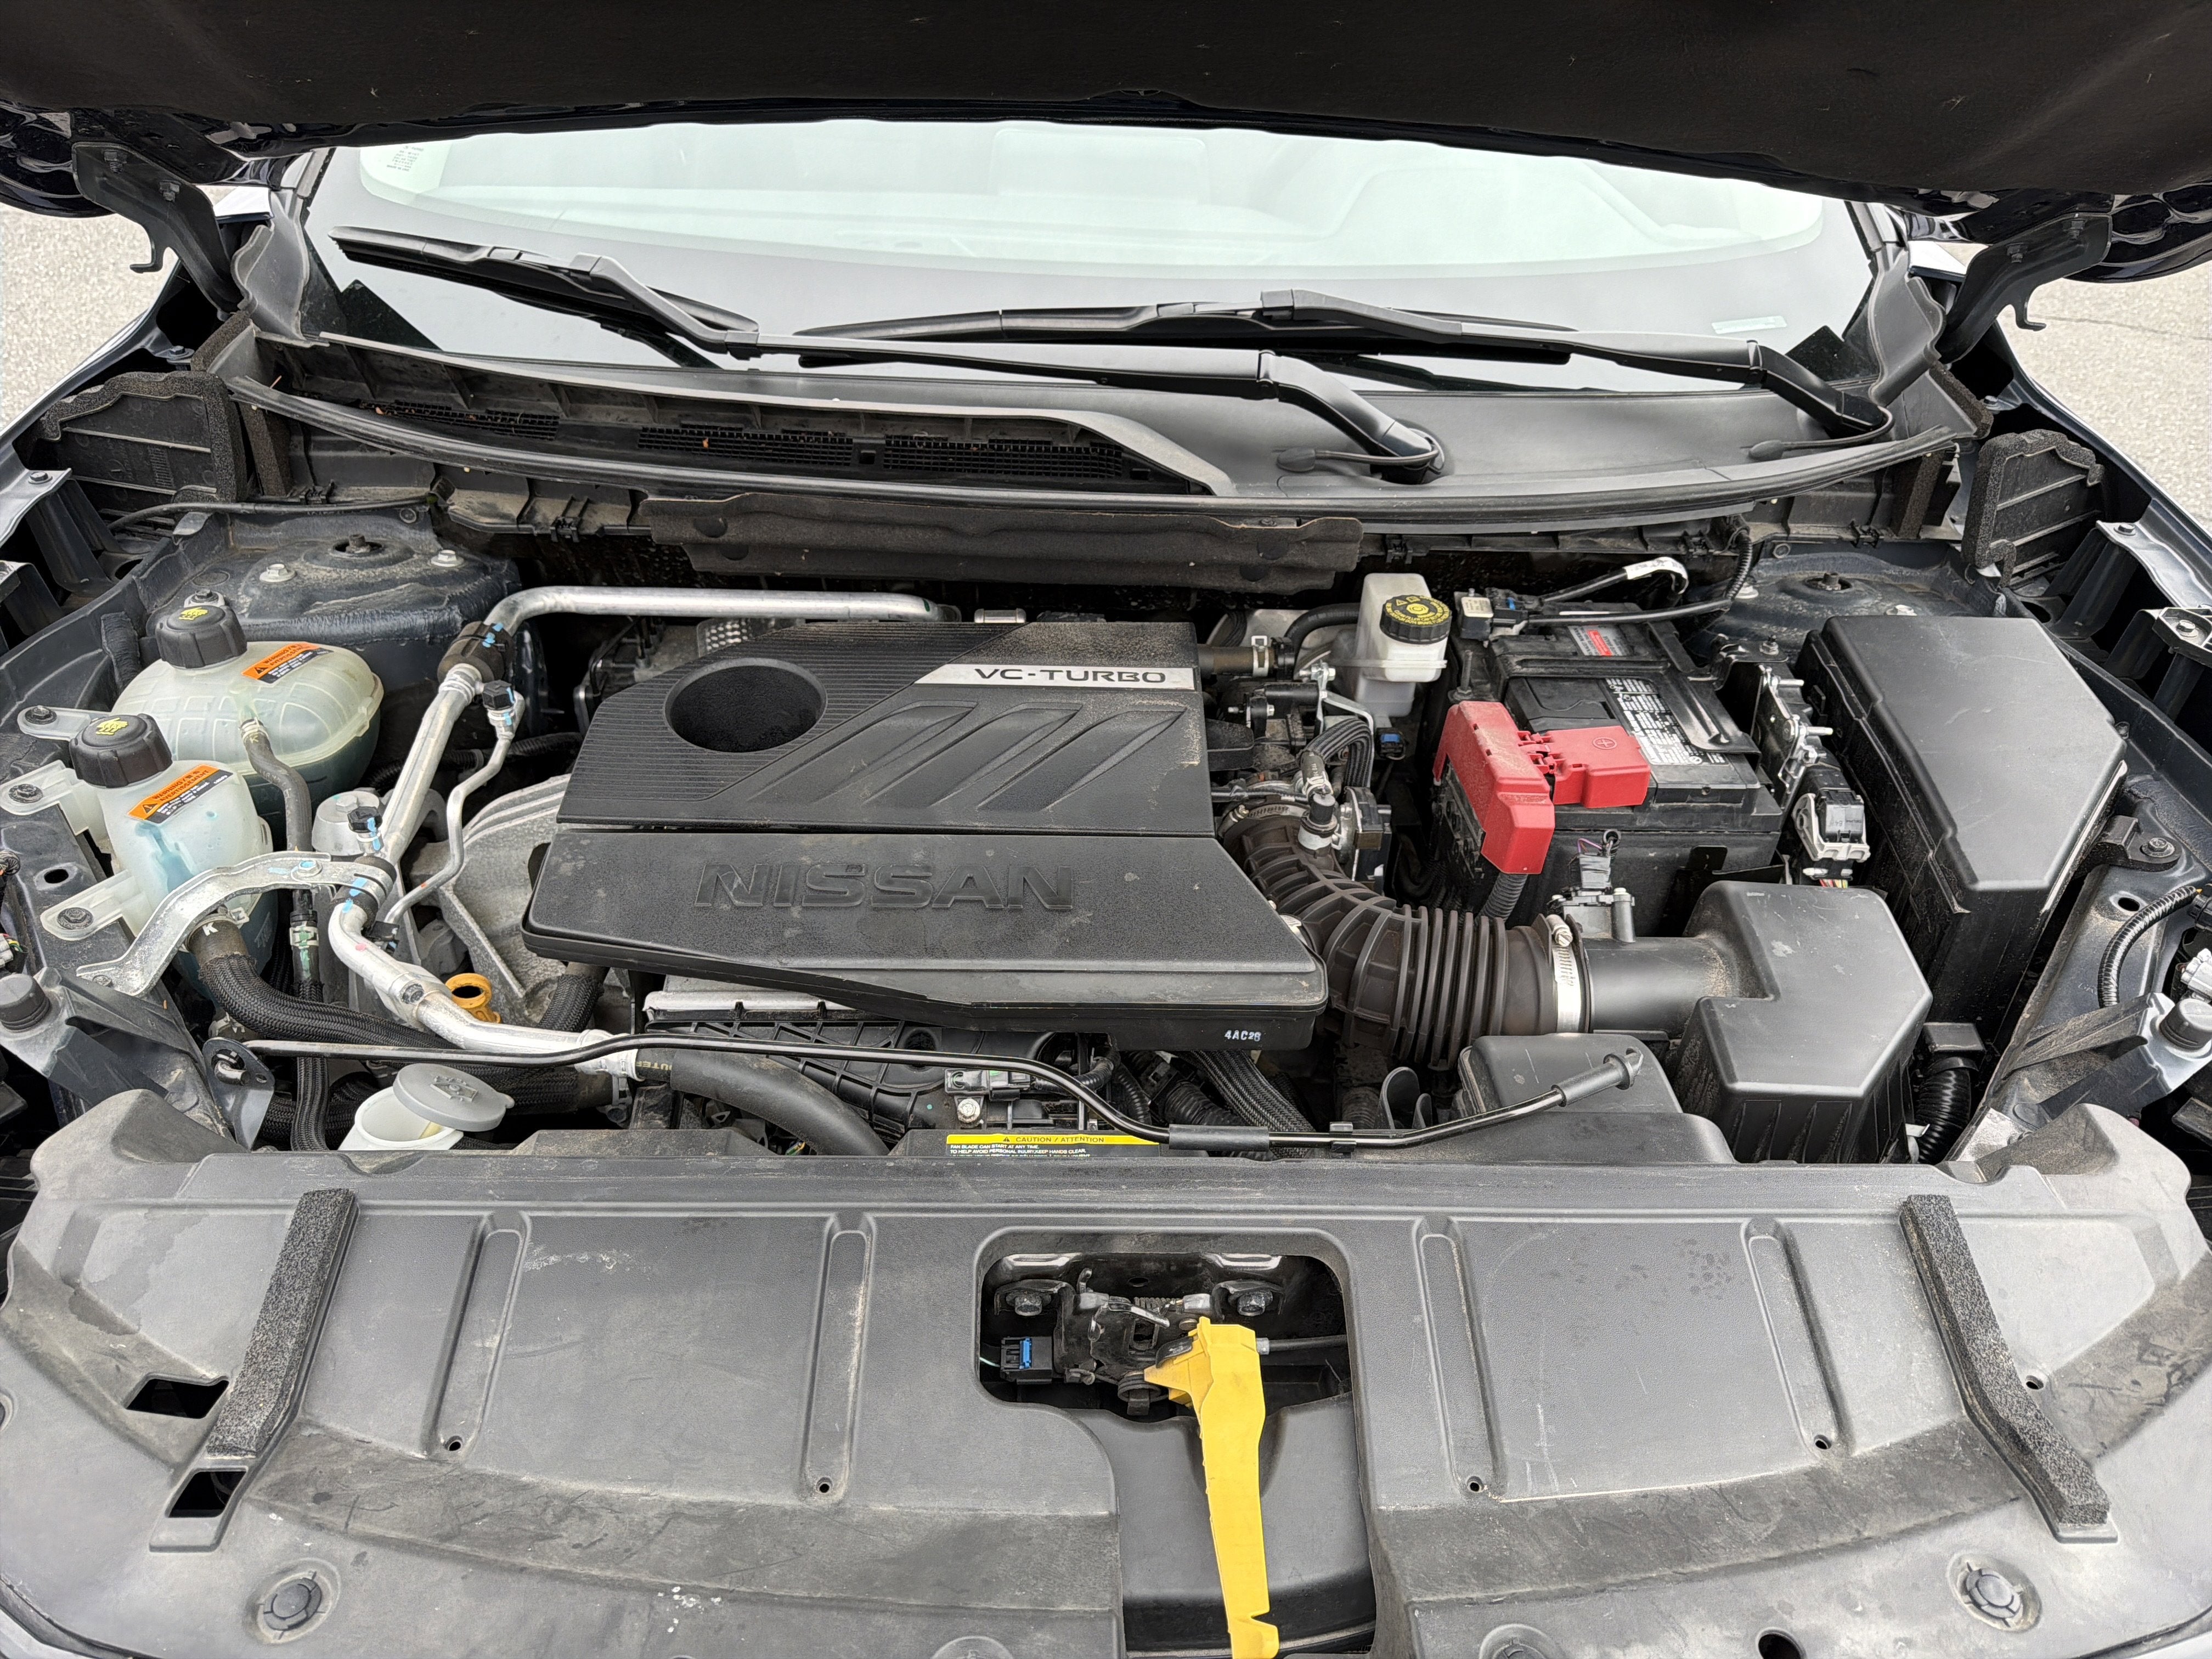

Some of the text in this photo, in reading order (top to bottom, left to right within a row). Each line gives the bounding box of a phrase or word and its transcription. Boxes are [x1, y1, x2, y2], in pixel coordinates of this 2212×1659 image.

[974, 667, 1166, 684] VC-TURBO
[152, 780, 183, 800] WARNING
[159, 769, 210, 802] AVERTISSEMENT
[694, 863, 1073, 910] NISSAN
[202, 922, 219, 936] K
[1224, 1030, 1262, 1042] 4AC28
